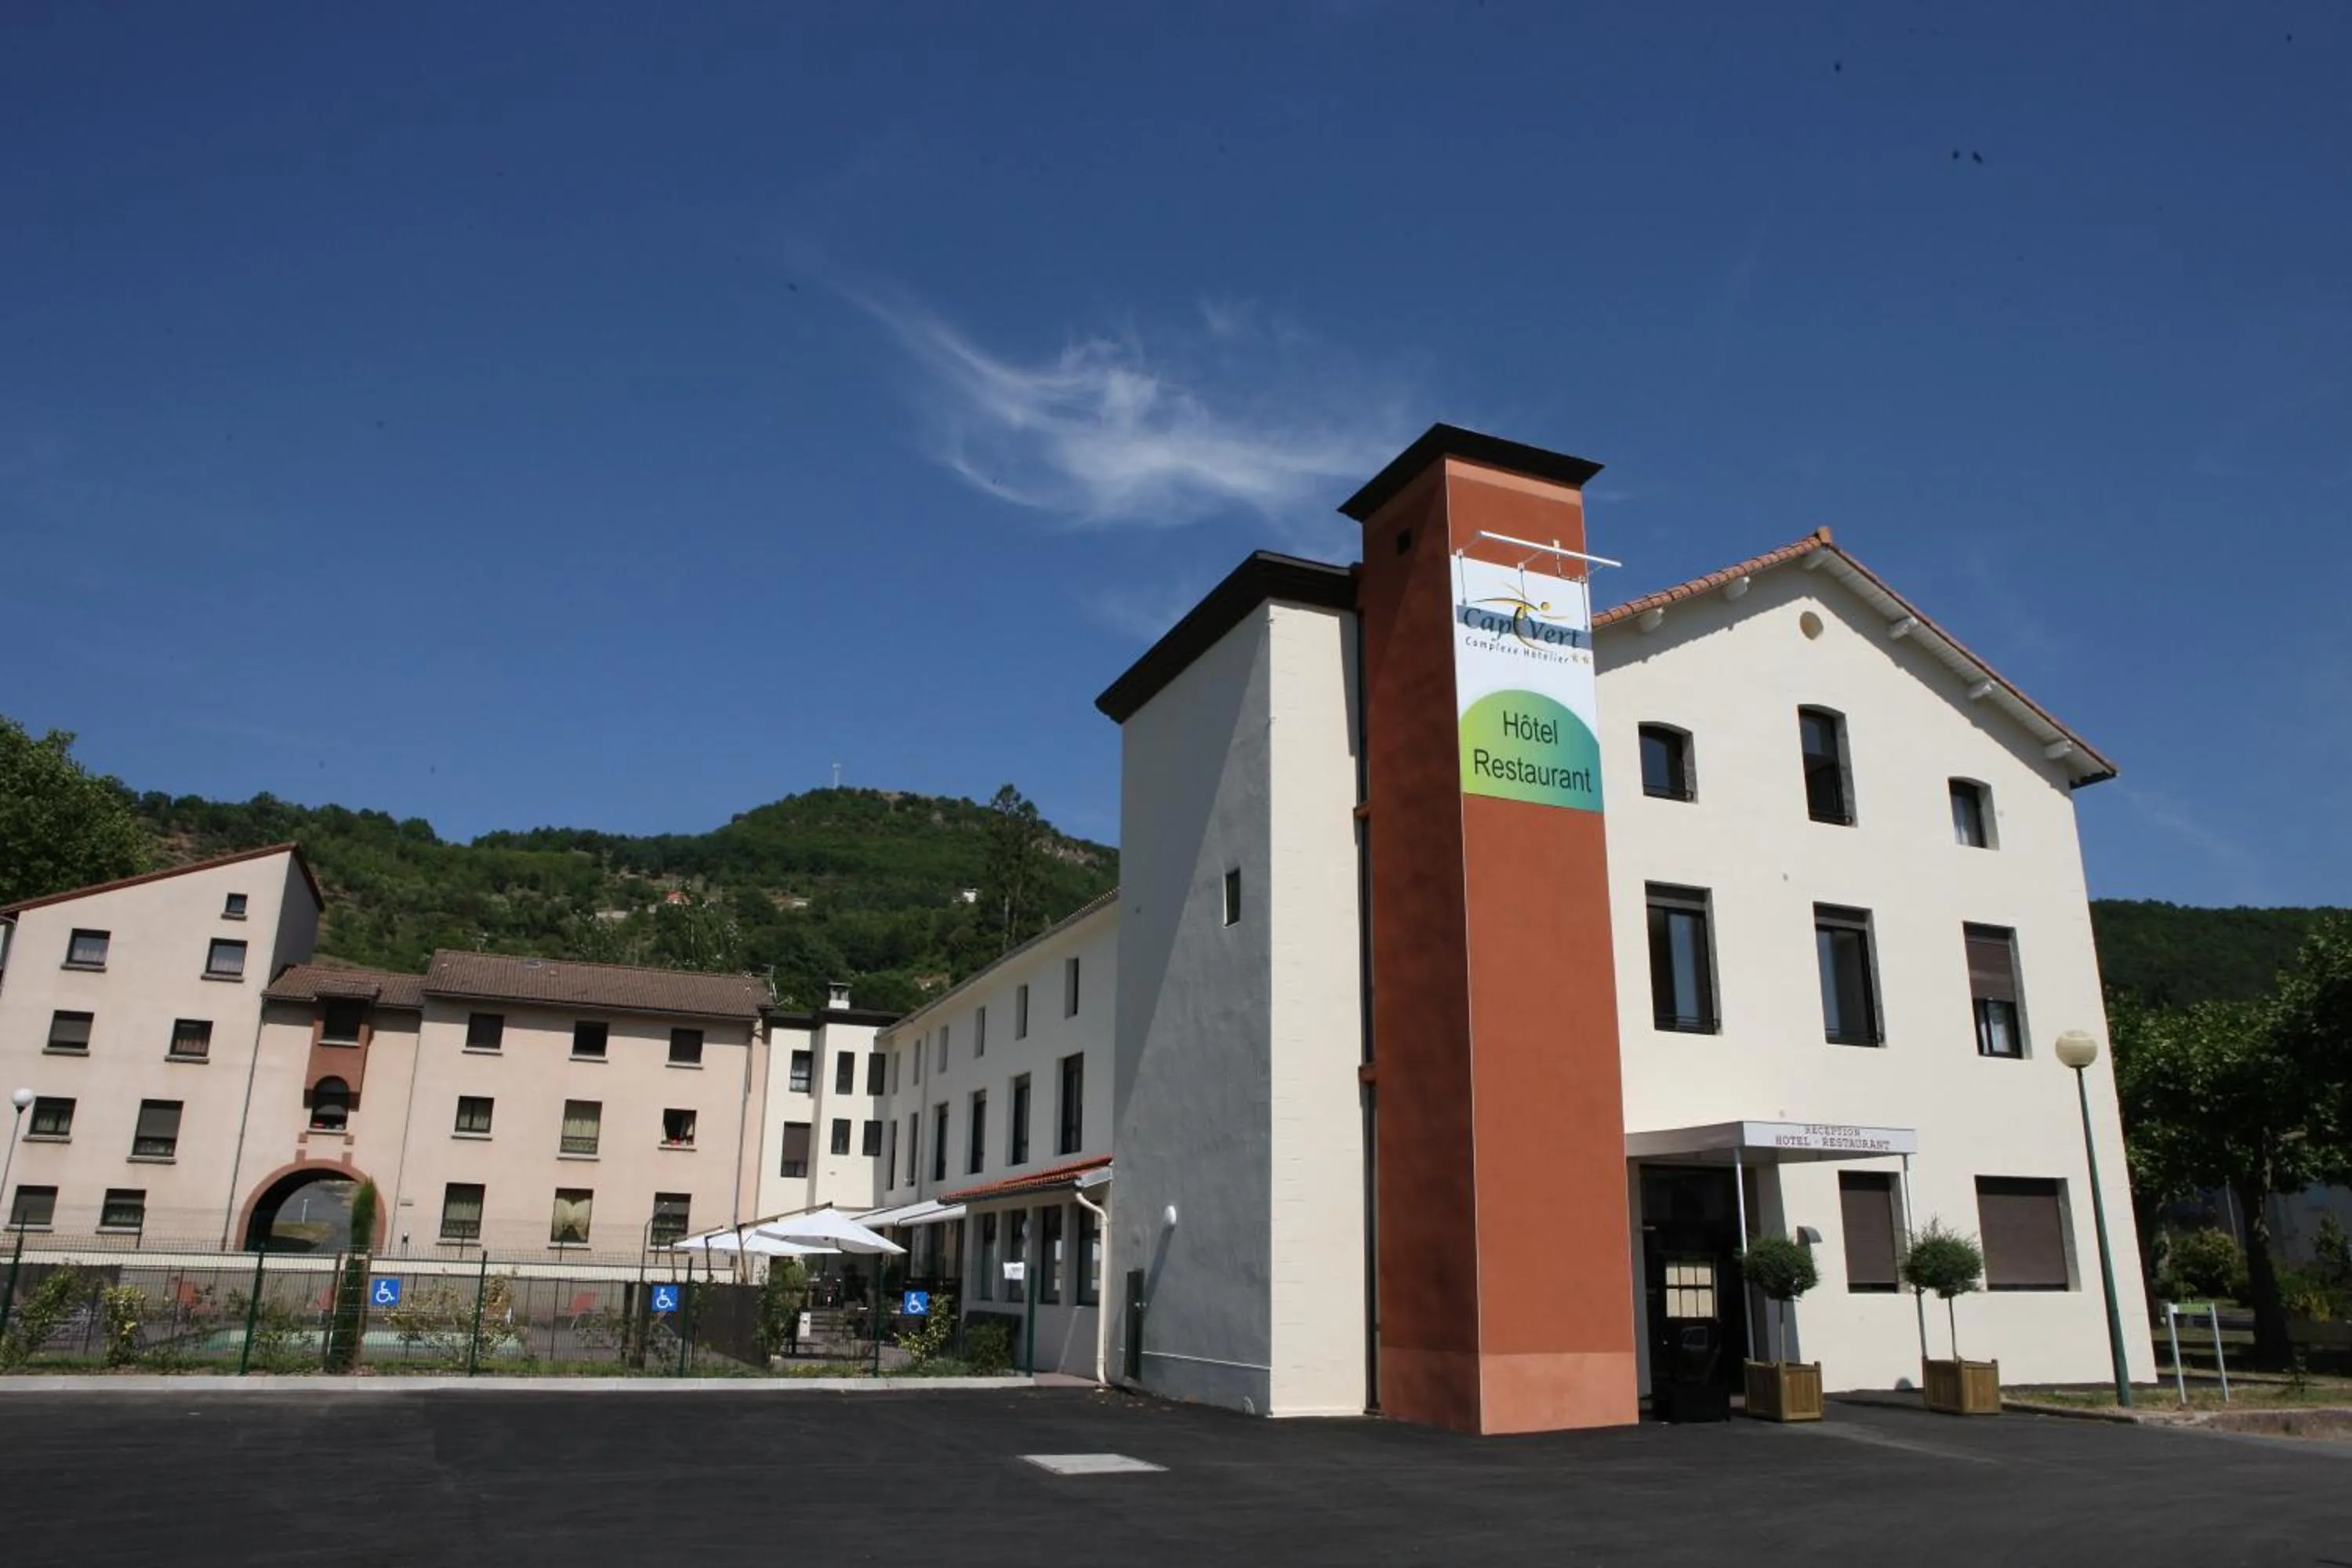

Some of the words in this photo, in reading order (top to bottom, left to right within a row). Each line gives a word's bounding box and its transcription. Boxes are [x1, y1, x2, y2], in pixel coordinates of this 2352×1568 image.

[1464, 608, 1511, 641] Cap
[1529, 617, 1581, 648] Vert
[1503, 710, 1558, 745] Hôtel
[1474, 749, 1592, 793] Restaurant
[1775, 1134, 1811, 1146] HOTEL
[1822, 1137, 1890, 1150] RESTAURANT
